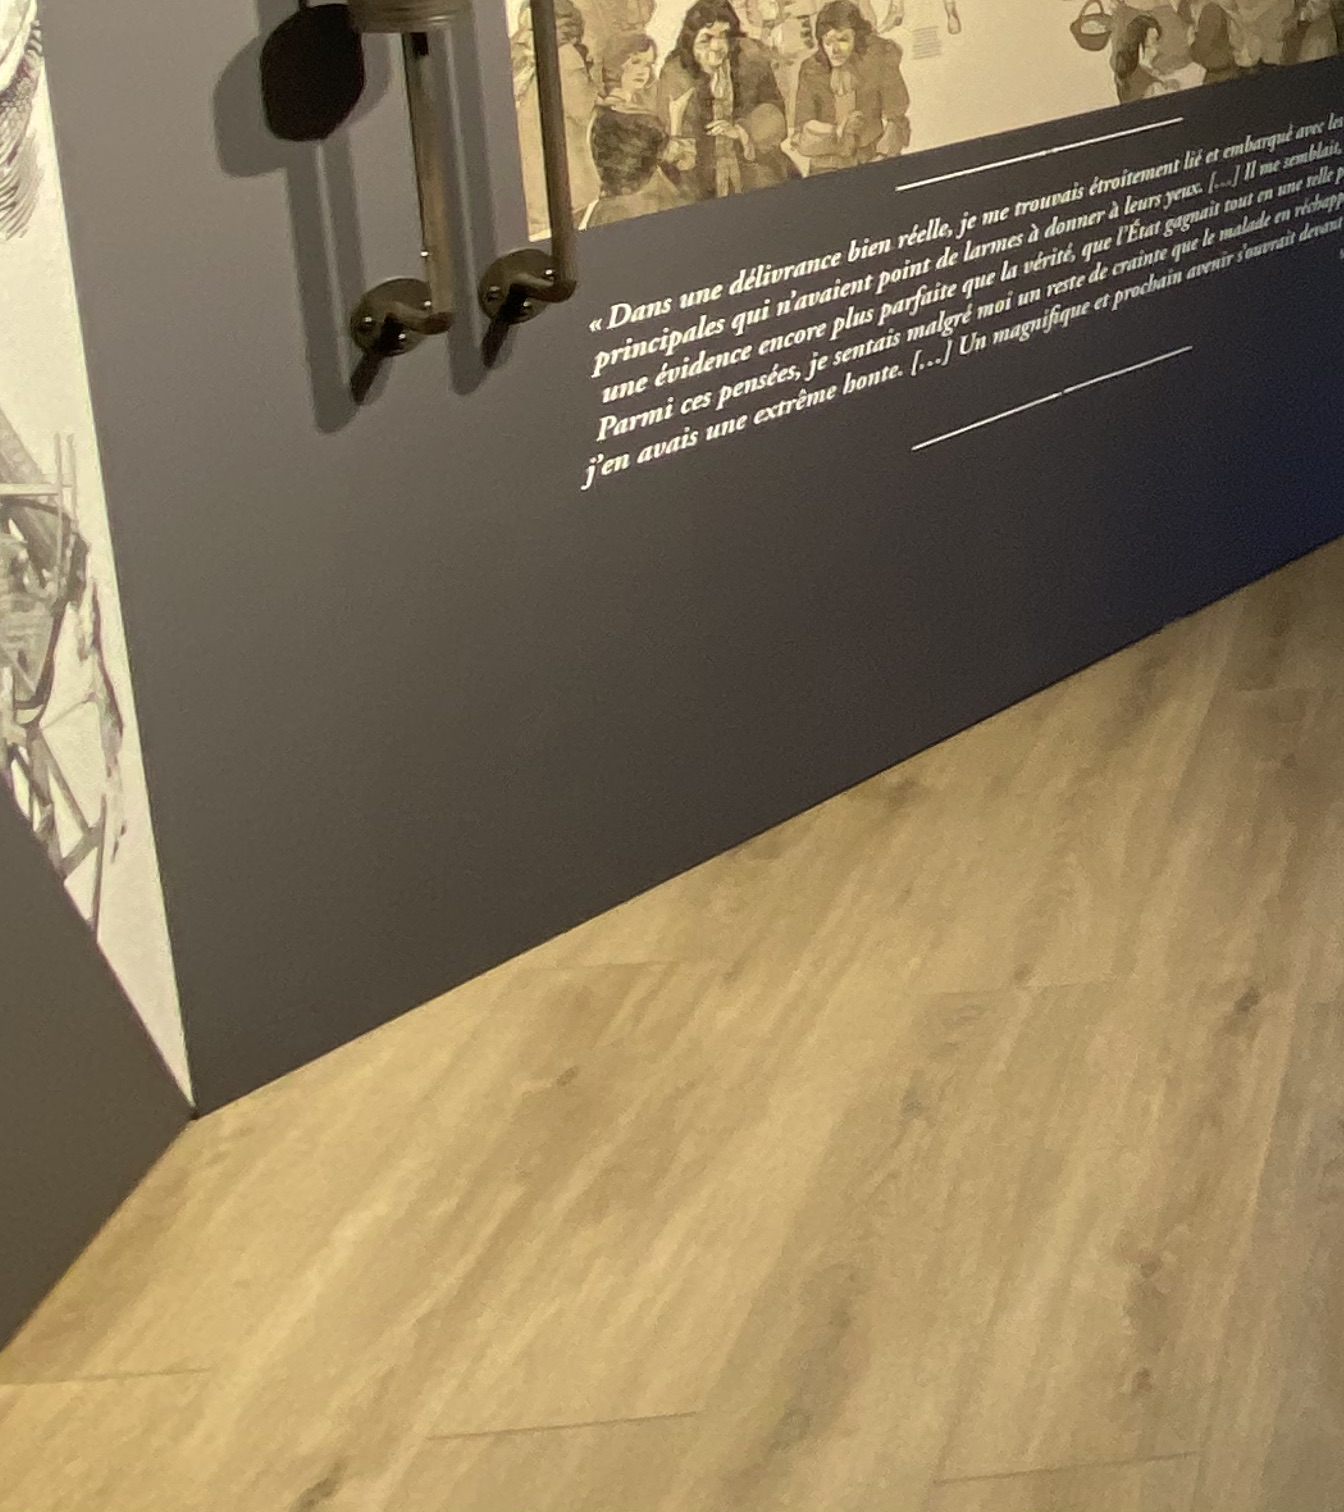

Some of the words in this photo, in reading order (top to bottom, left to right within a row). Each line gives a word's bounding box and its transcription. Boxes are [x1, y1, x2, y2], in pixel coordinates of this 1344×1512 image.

[589, 313, 726, 379] principales
[730, 297, 771, 336] qui
[874, 256, 932, 295] point
[934, 245, 959, 270] de
[962, 232, 1024, 262] larmes
[1026, 222, 1040, 244] à
[1043, 209, 1106, 239] donner
[1107, 199, 1119, 220] à
[601, 375, 649, 404] une
[653, 344, 753, 387] évidence
[757, 321, 827, 356] encore
[828, 305, 875, 341] plus
[876, 280, 958, 326] parfaite
[960, 270, 996, 300] que
[999, 259, 1018, 282] la
[1022, 241, 1076, 274] vérité,
[1080, 235, 1113, 262] que
[605, 296, 673, 330] Dans
[678, 283, 724, 309] une
[727, 251, 842, 296] délivrance
[846, 236, 891, 263] bien
[896, 215, 953, 249] réelle,
[954, 210, 978, 240] je
[981, 205, 1010, 226] me
[1013, 180, 1085, 217] trouvais
[1087, 157, 1181, 197] étroitement
[595, 395, 674, 442] Parmi
[679, 390, 713, 415] ces
[714, 362, 801, 411] pensées,
[803, 350, 829, 382] je
[831, 327, 901, 366] sentais
[905, 302, 973, 342] malgré
[976, 289, 1013, 320] moi
[1016, 287, 1041, 307] un
[1045, 273, 1086, 298] reste
[1087, 260, 1109, 284] de
[1111, 247, 1168, 276] crainte
[635, 425, 699, 464] avais
[704, 413, 748, 441] une
[752, 384, 838, 425] extrême
[841, 363, 903, 395] honte.
[958, 330, 987, 355] Un
[991, 300, 1091, 345] magnifique
[1092, 292, 1111, 311] et
[1110, 267, 1183, 312] prochain
